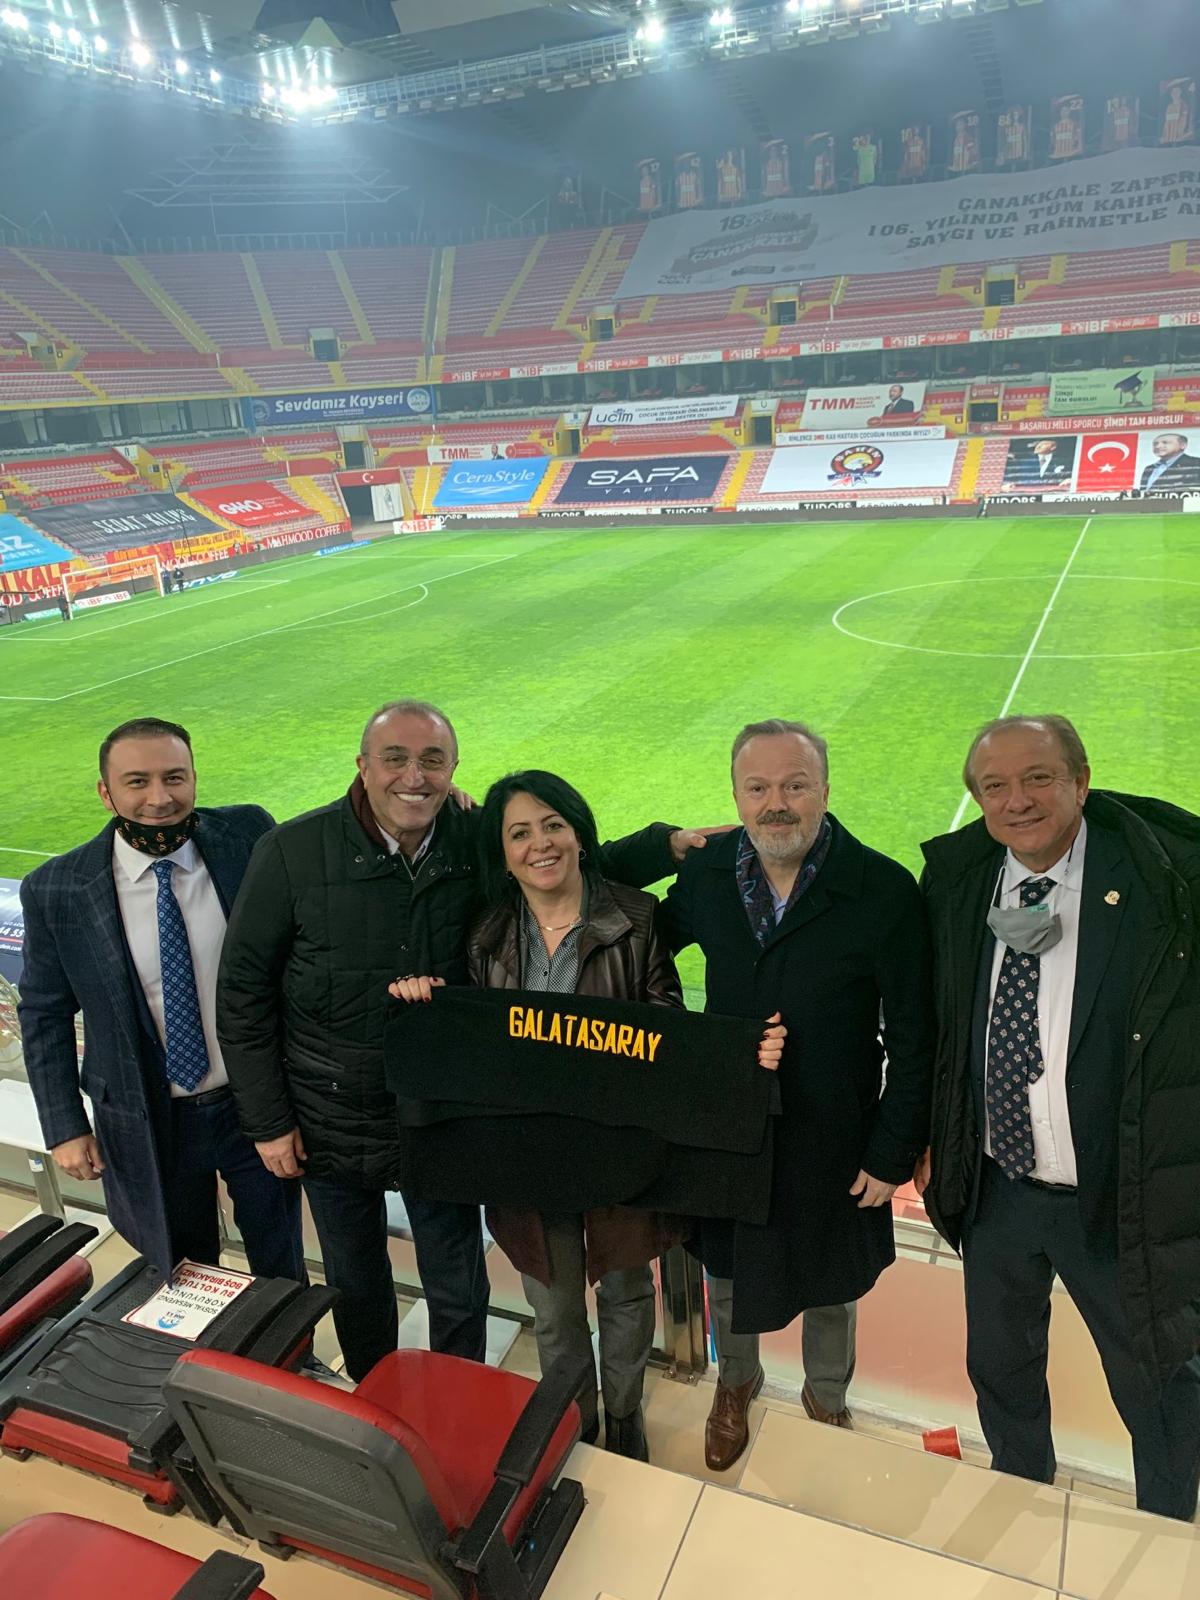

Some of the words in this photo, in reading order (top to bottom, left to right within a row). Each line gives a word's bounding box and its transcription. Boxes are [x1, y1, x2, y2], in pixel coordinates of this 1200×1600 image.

[1110, 170, 1200, 194] ZAFER
[926, 212, 1019, 231] YILINDA
[1029, 201, 1083, 219] TÜM
[907, 228, 975, 248] SAYGI
[984, 227, 1015, 240] VE
[1023, 207, 1168, 236] RAHMETLE
[275, 396, 346, 413] Sevdamız
[349, 392, 404, 410] Kayseri
[809, 398, 857, 411] TMM
[1073, 418, 1102, 428] SPORCU
[1103, 416, 1127, 429] ŞİMDİ
[1128, 416, 1146, 427] TAM
[1147, 414, 1183, 426] BURSLU!
[439, 448, 469, 460] TMM
[453, 469, 536, 485] CeraStyle
[587, 466, 699, 487] SAFA
[266, 530, 314, 549] MAHMOOD
[315, 524, 342, 539] COFFEE
[509, 1005, 662, 1064] GALATASARAY
[174, 1277, 220, 1294] KOLTUĞU
[223, 1279, 243, 1290] BOŞ
[221, 1289, 236, 1298] BU
[195, 1303, 218, 1315] SOSYAL
